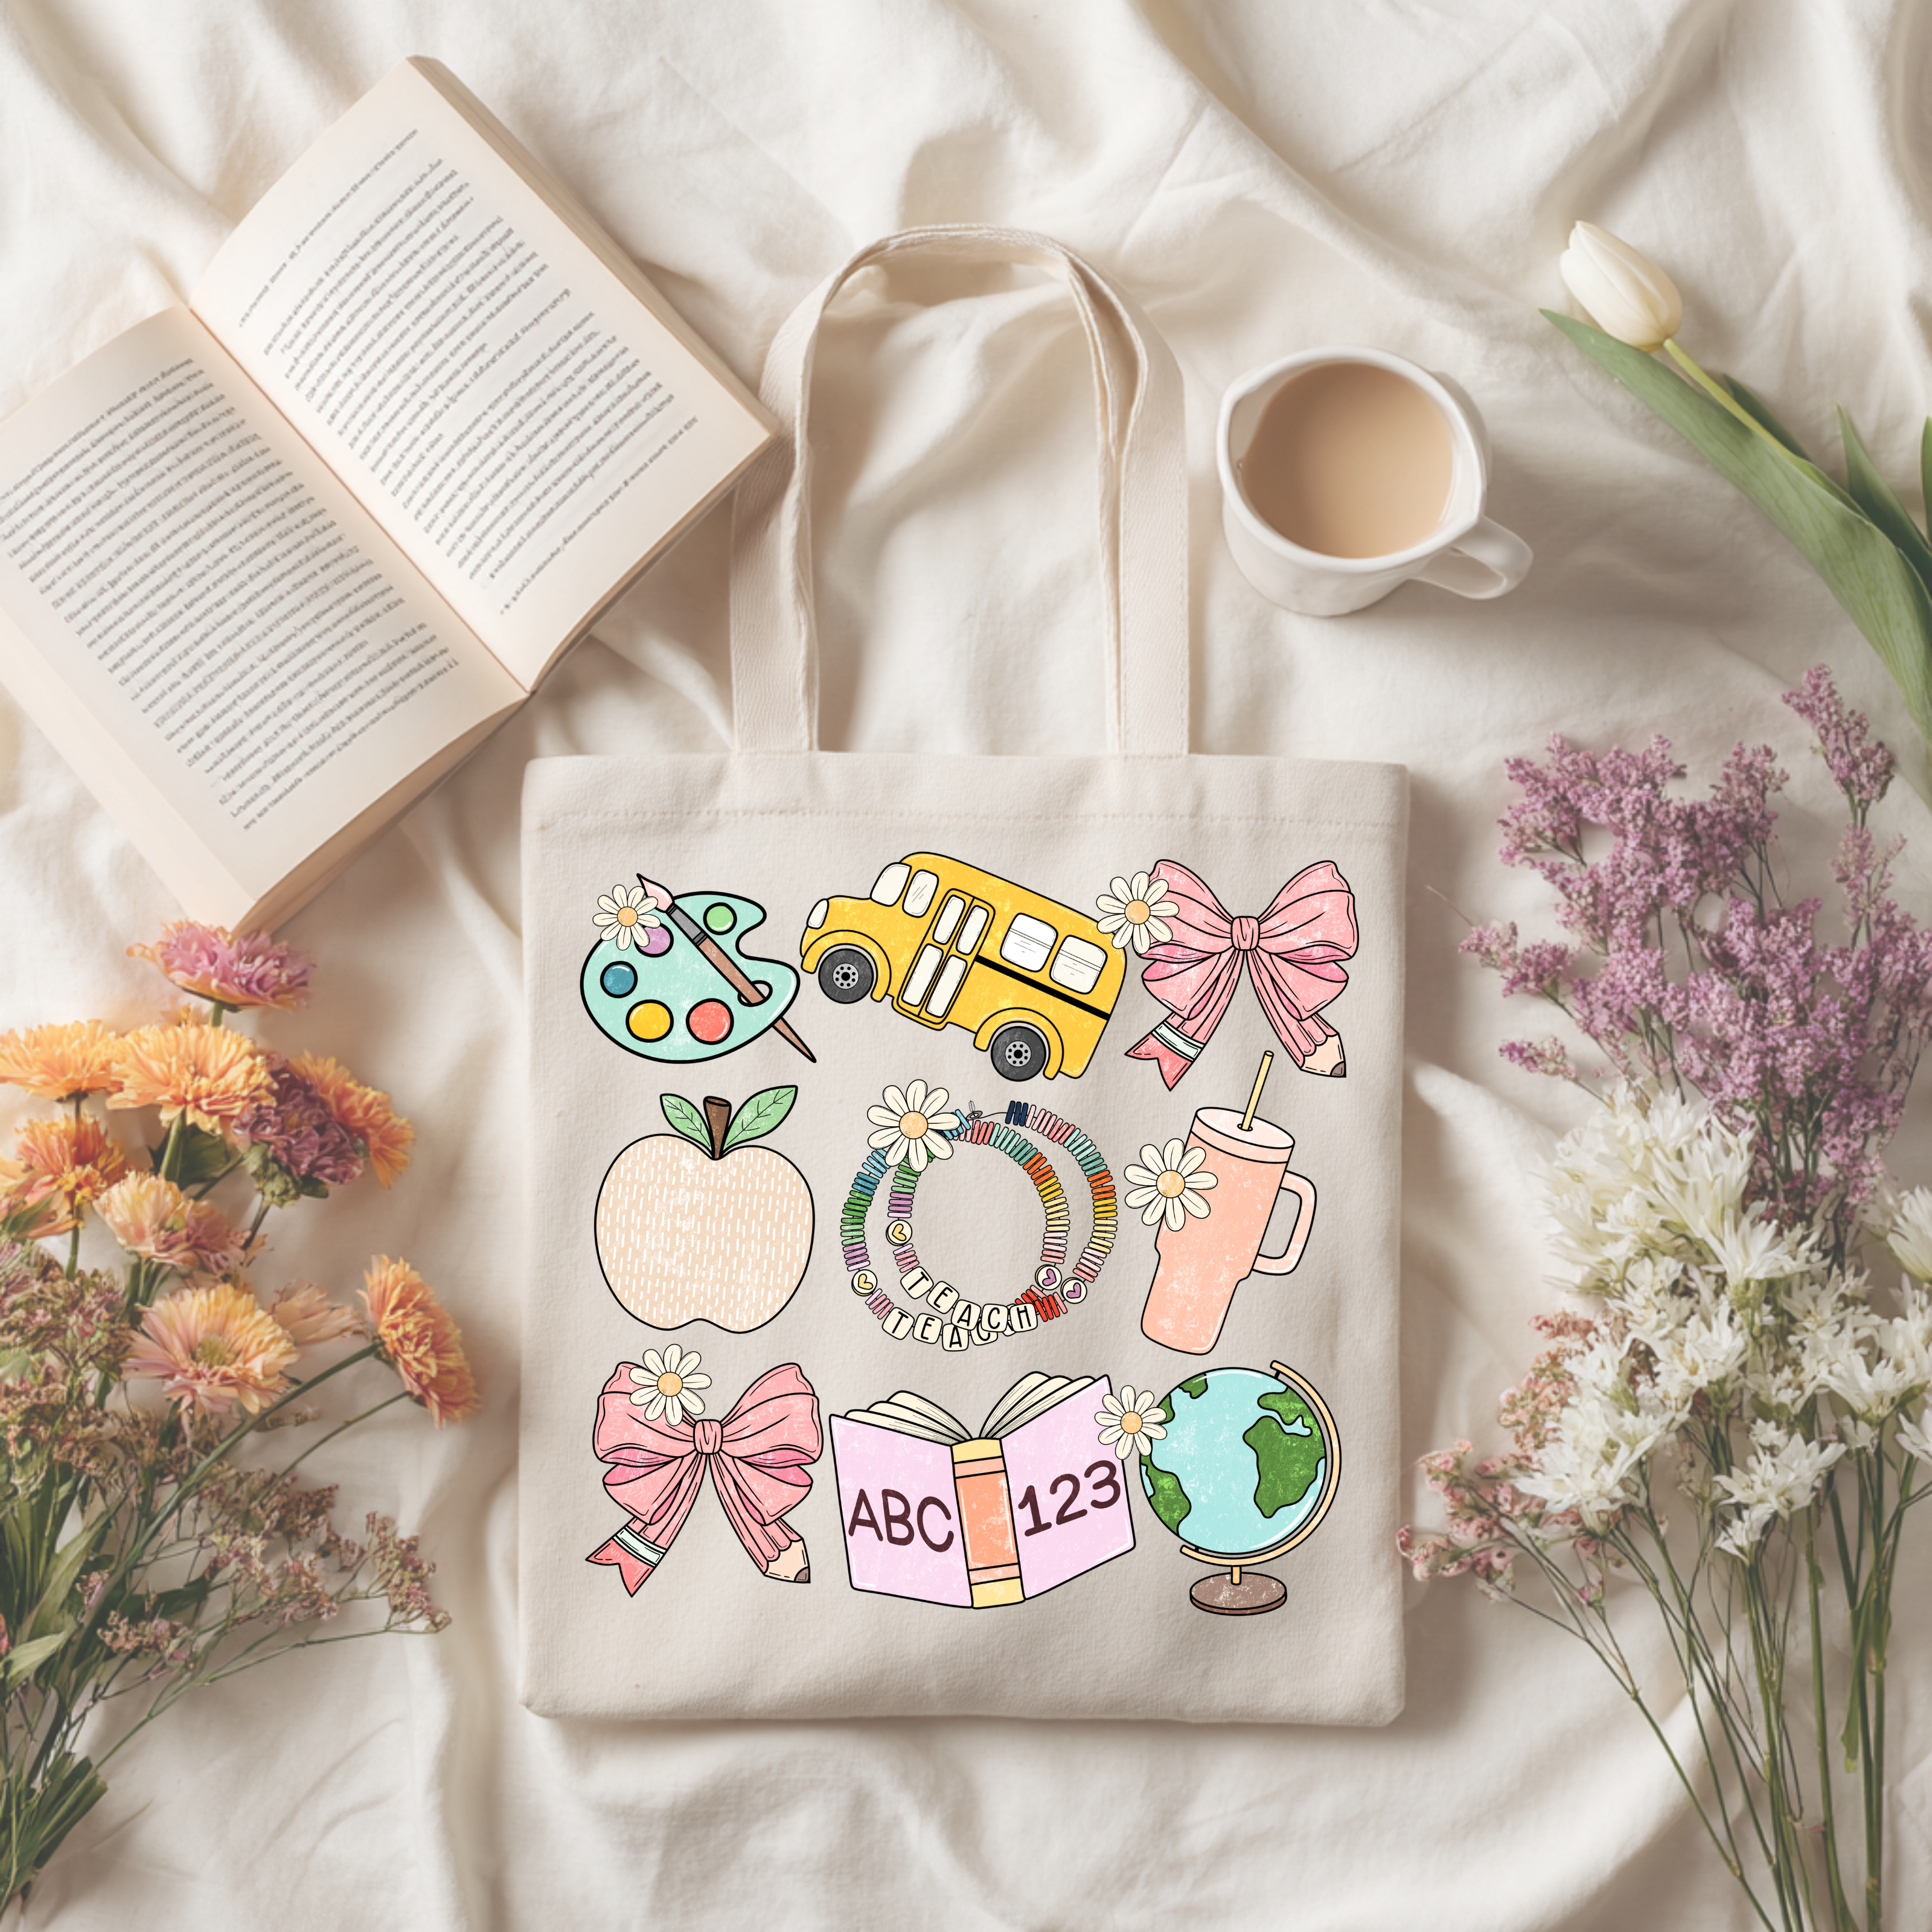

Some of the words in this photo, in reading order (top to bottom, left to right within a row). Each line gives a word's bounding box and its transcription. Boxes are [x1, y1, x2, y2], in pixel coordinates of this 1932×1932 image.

[892, 1311, 1014, 1348] TEAC
[907, 1271, 1032, 1329] TEACH
[848, 1488, 955, 1553] ABC
[1017, 1459, 1121, 1537] 123
